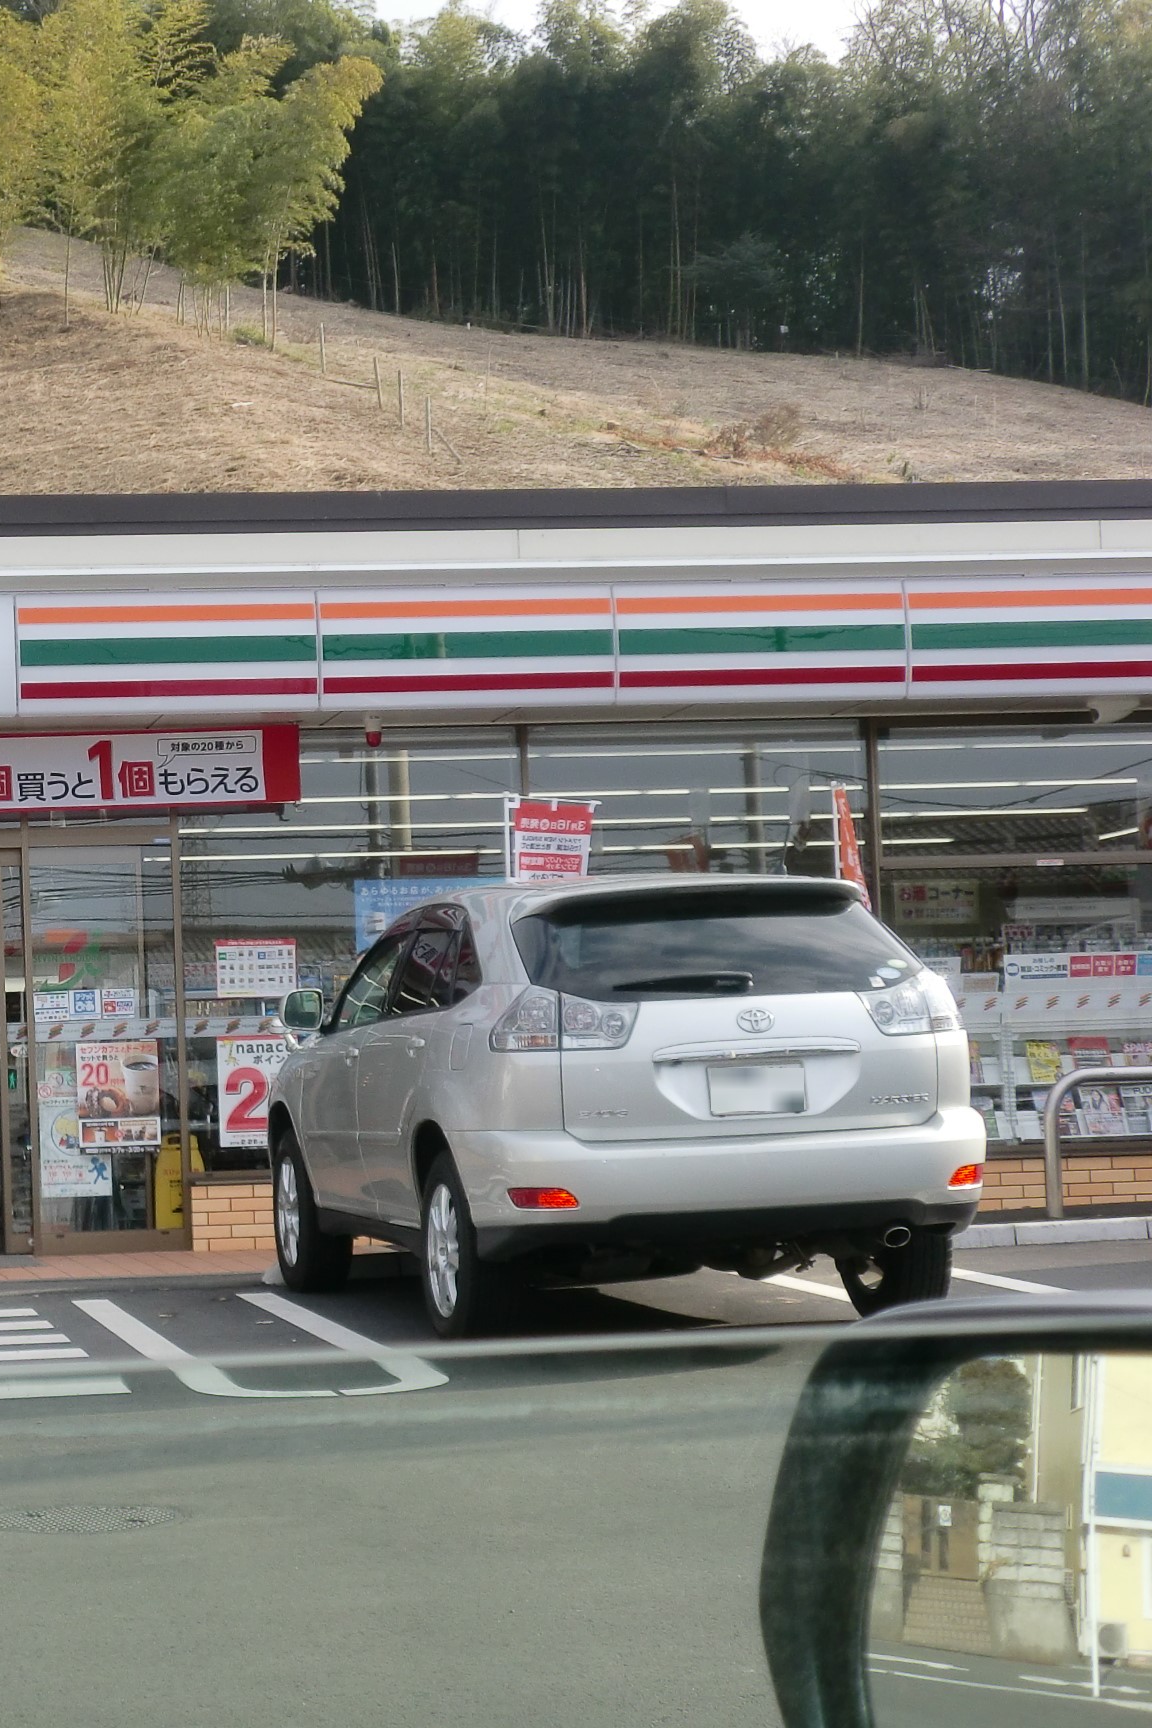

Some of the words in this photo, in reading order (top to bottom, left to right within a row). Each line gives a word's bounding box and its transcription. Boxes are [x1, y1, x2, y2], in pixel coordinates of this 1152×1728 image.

[170, 740, 244, 752] 対象の20種から
[81, 1062, 109, 1087] 20
[225, 1067, 268, 1133] 2
